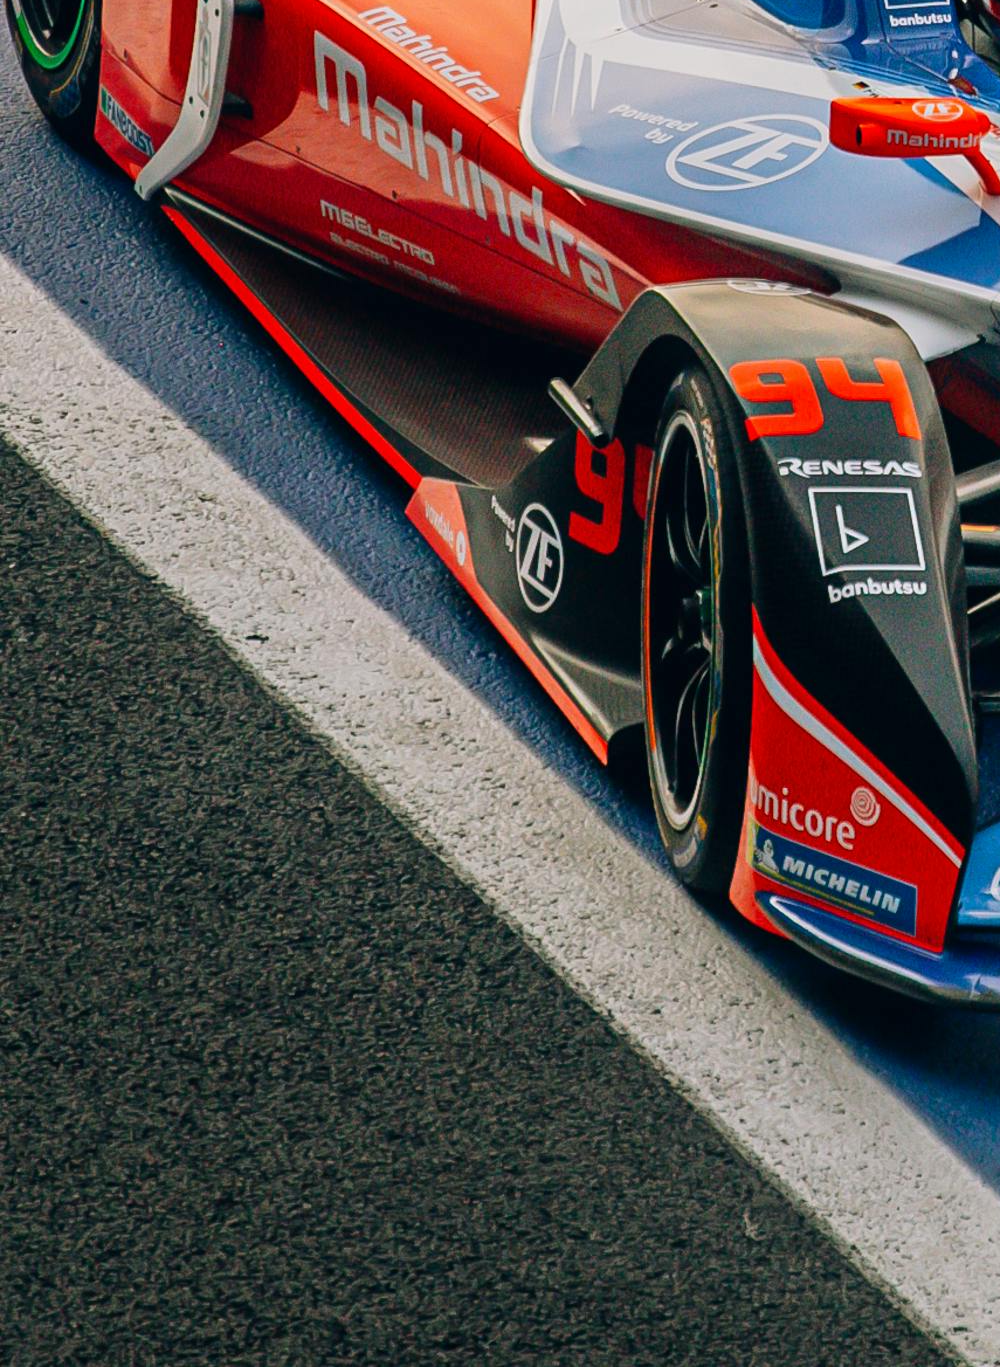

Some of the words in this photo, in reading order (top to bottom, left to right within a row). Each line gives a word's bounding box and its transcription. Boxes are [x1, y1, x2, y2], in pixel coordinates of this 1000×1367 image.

[889, 11, 953, 28] banbutsu
[358, 5, 499, 104] Mahindra
[608, 103, 699, 132] Powered
[644, 127, 676, 144] by
[887, 128, 983, 150] Mahindr
[314, 29, 622, 311] Mahindra
[670, 116, 824, 187] ZF
[728, 356, 920, 441] 94
[777, 458, 923, 478] RENESAS
[518, 509, 562, 608] ZF
[828, 577, 927, 604] banbutsu
[782, 855, 901, 915] MICHELIN
